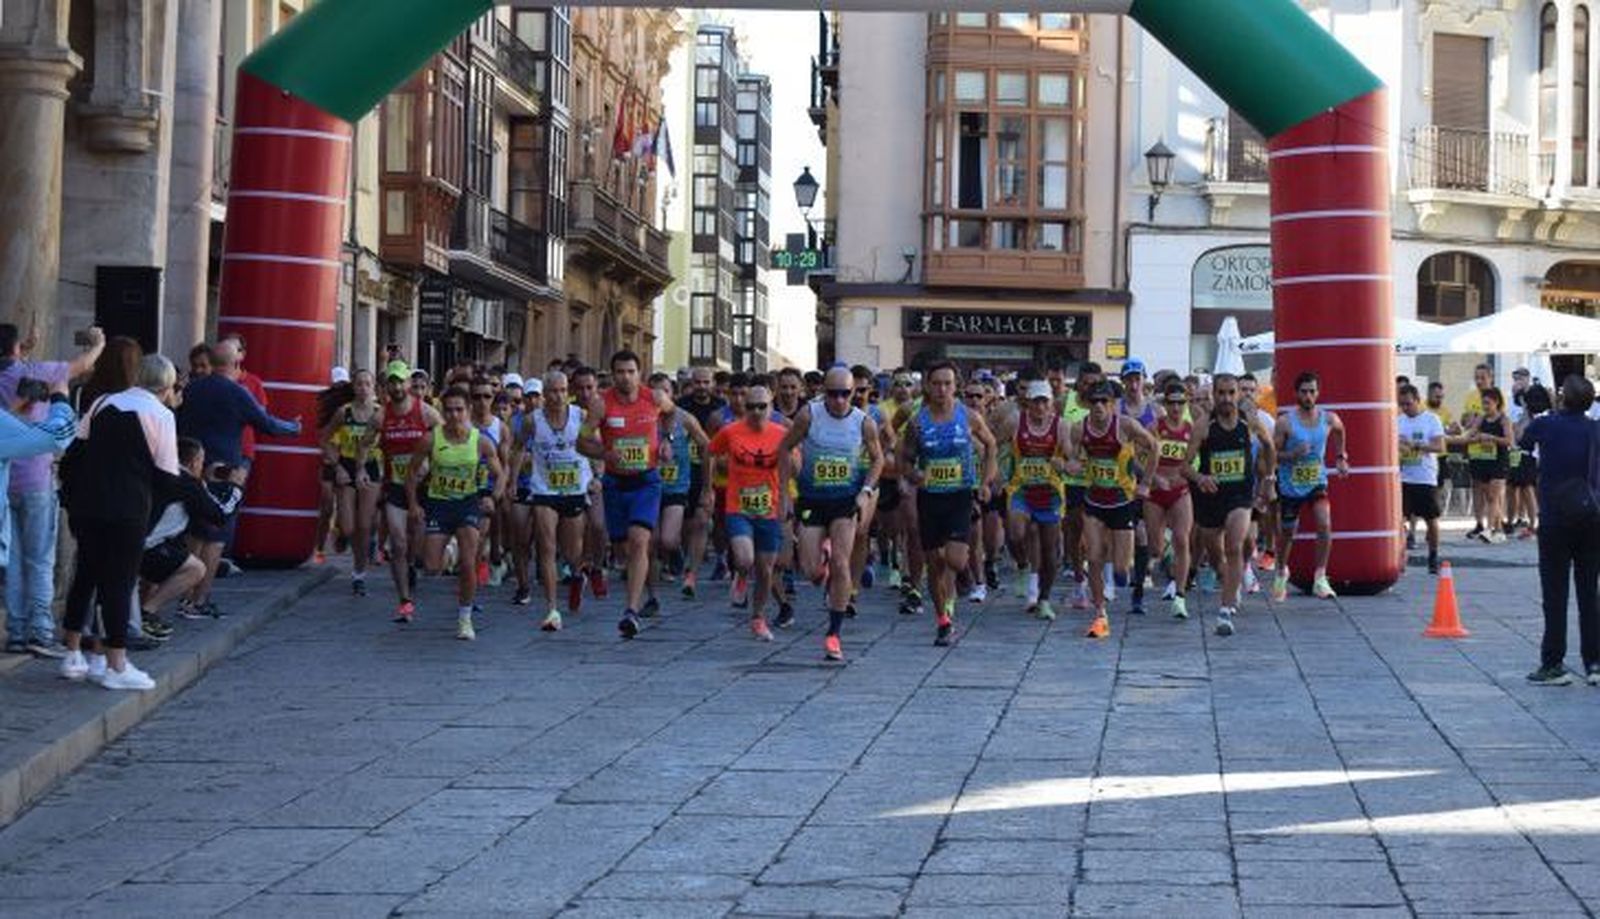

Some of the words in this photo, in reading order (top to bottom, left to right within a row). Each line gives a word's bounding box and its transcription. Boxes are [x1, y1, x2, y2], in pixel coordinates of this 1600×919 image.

[775, 252, 817, 268] 10:29
[941, 315, 1054, 334] FARMACIA
[816, 463, 849, 478] 938
